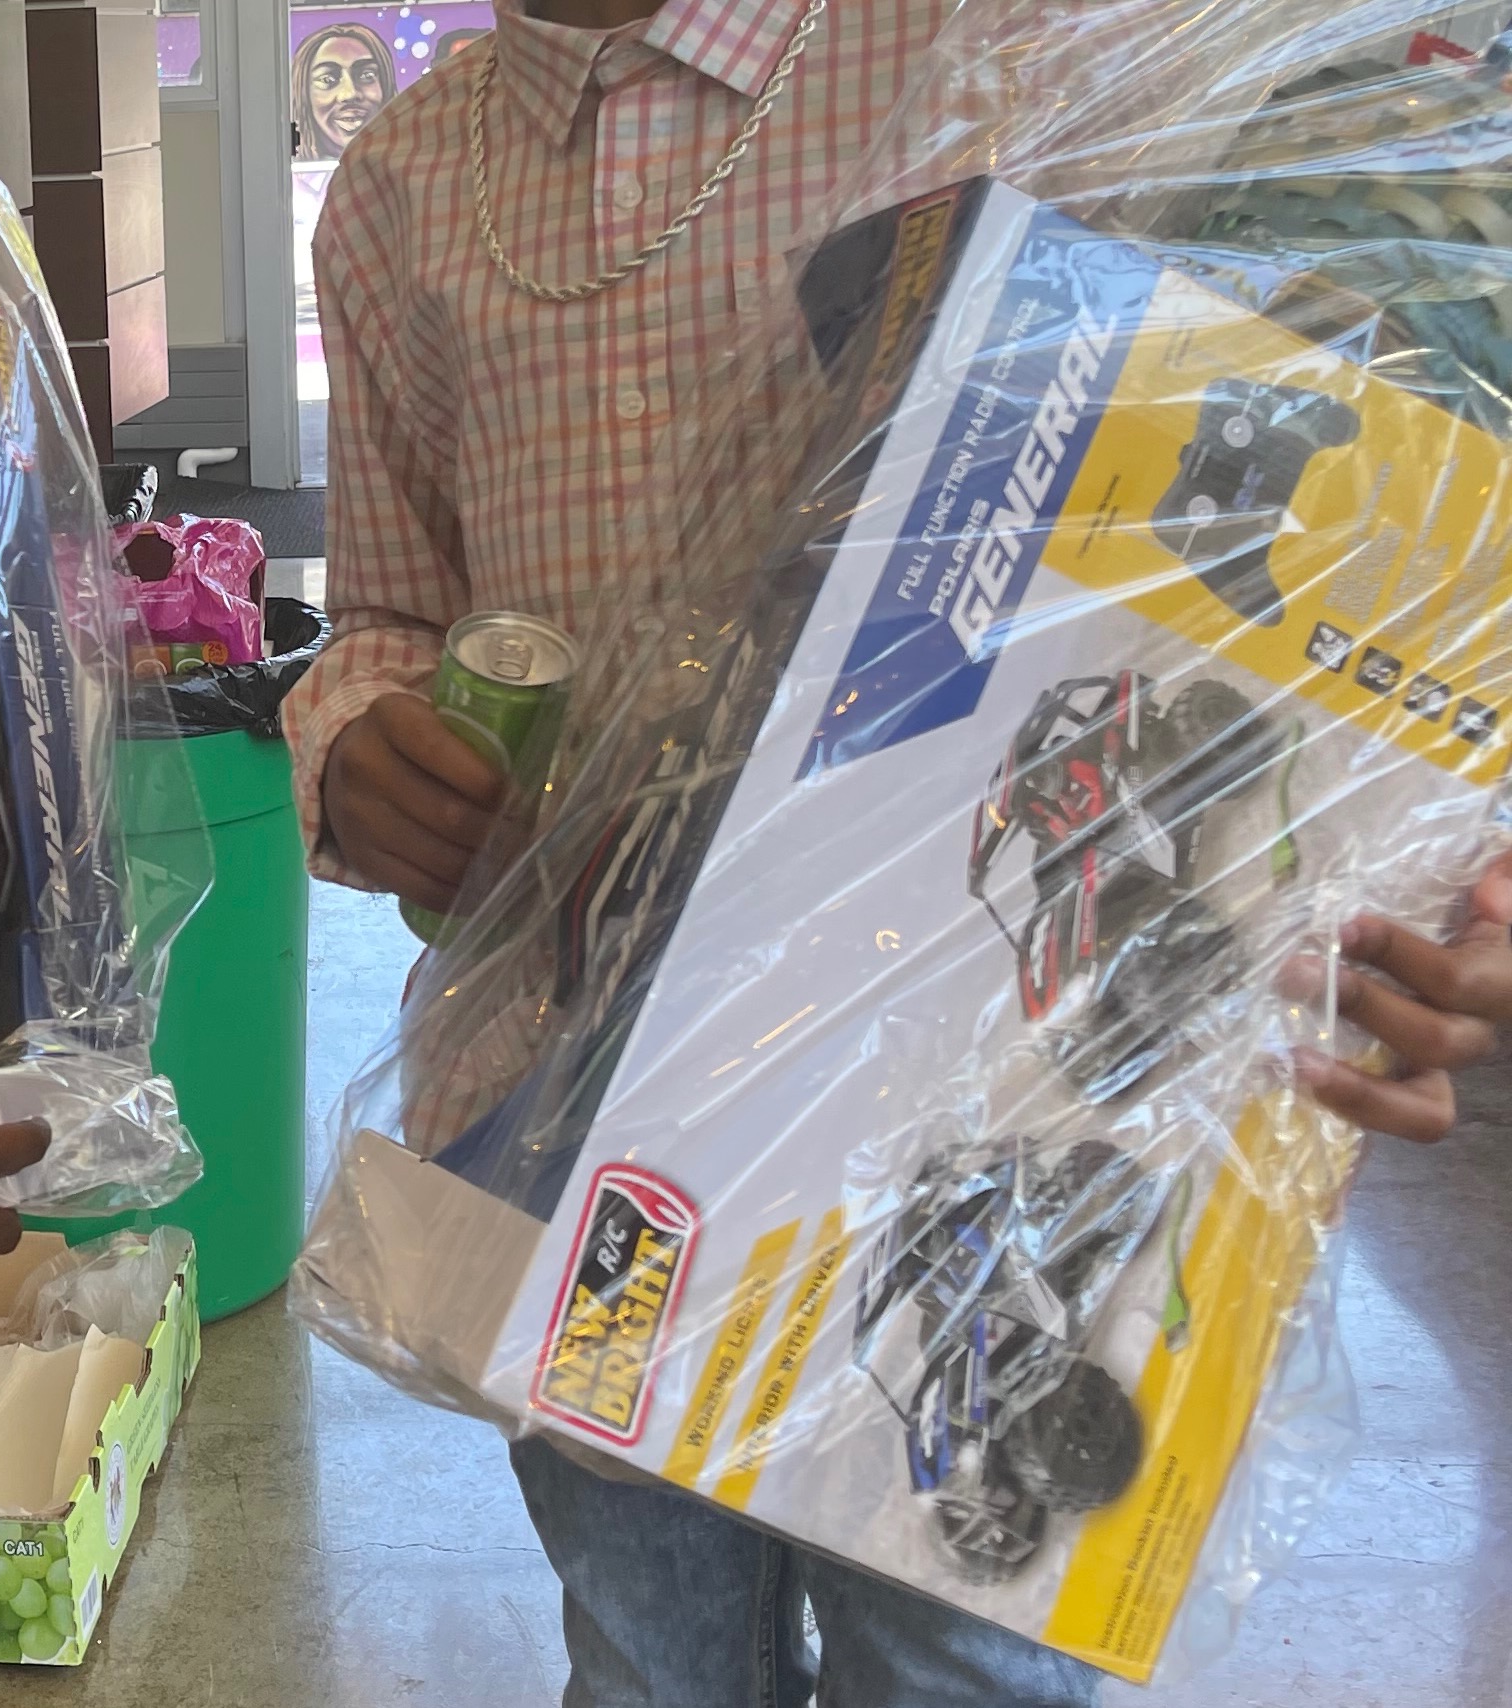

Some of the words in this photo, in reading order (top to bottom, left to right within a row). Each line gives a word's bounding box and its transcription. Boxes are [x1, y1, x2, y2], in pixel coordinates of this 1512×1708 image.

[897, 553, 931, 601] FULL
[921, 449, 974, 546] FUNCTION
[928, 498, 991, 617] POLARIS
[947, 313, 1120, 657] GENERAL
[11, 609, 72, 930] GENERAL
[547, 1283, 611, 1408] NEW
[595, 1219, 628, 1275] R/C
[590, 1227, 676, 1430] BRIGHT
[685, 1356, 736, 1448] WORKING
[3, 1539, 45, 1556] CAT1
